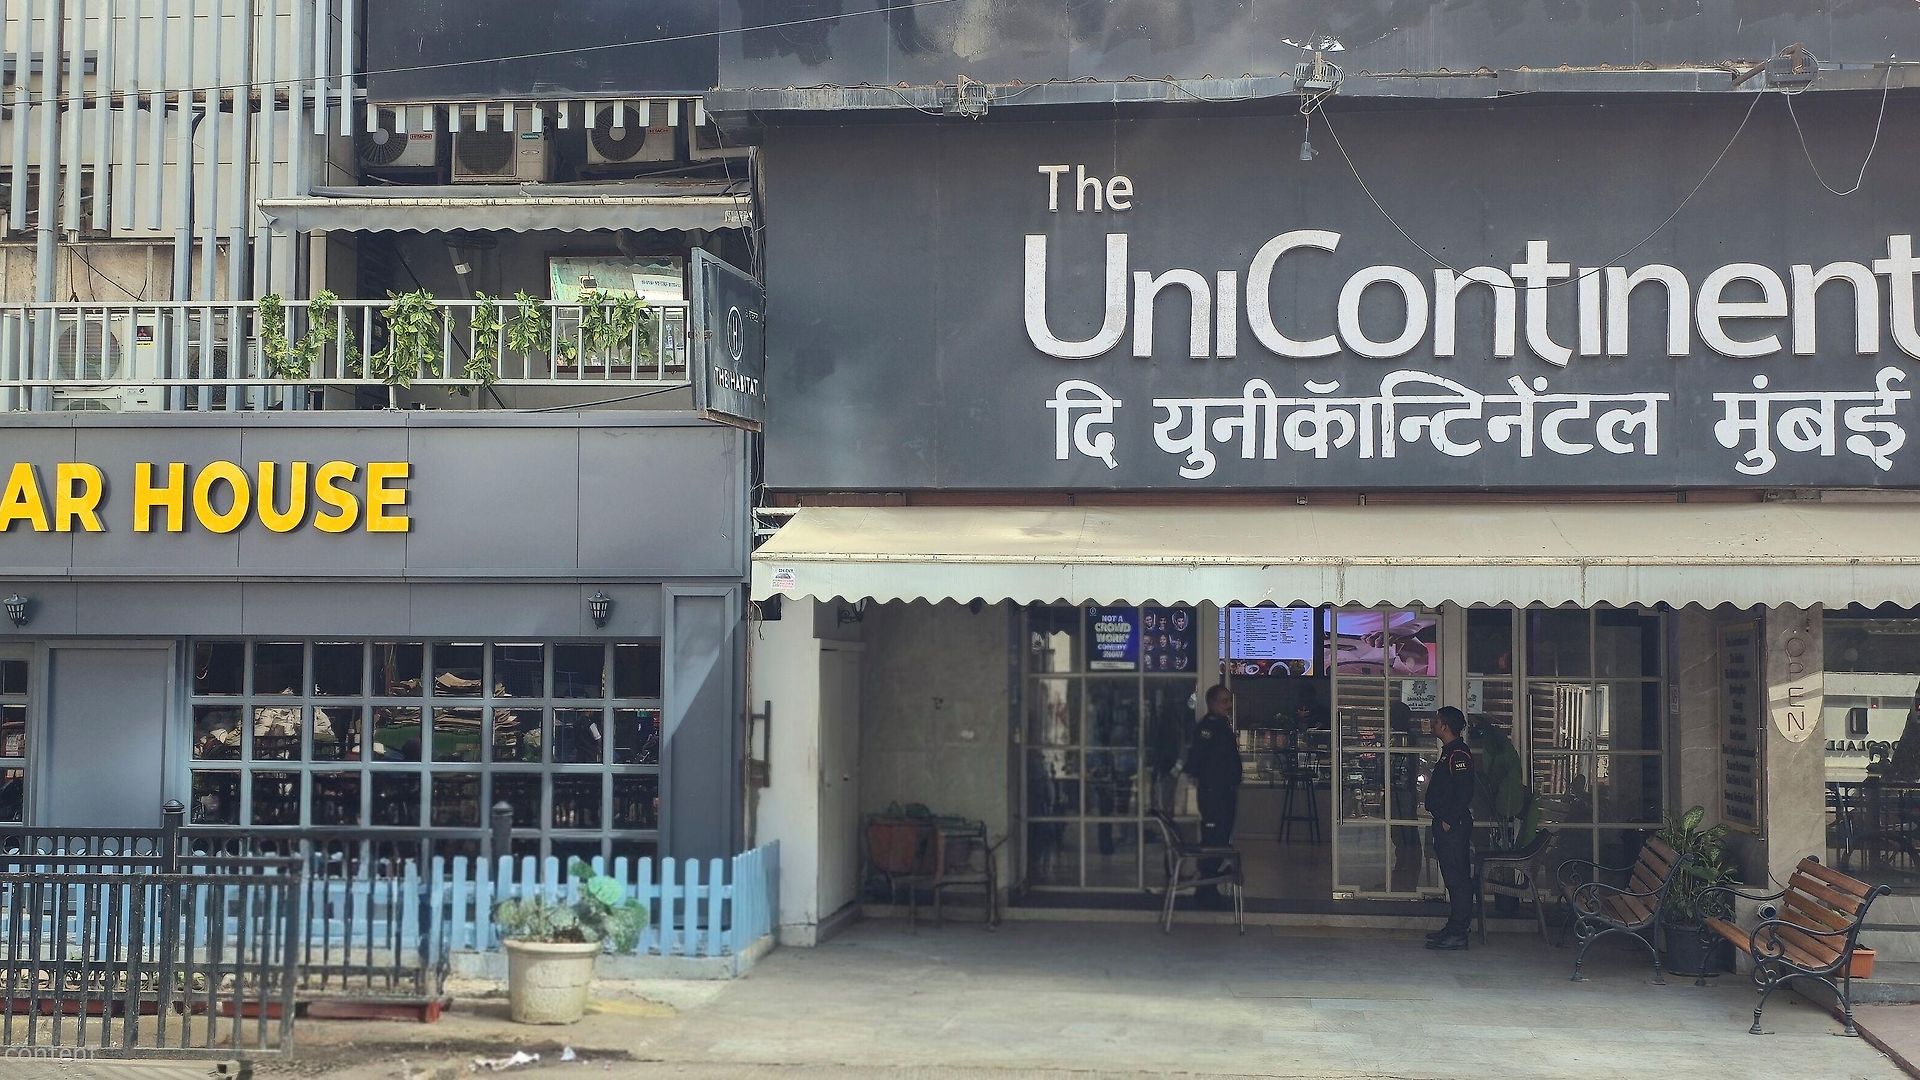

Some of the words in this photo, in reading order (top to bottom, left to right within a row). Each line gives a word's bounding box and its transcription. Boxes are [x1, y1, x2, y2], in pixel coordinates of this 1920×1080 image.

[1038, 164, 1134, 213] The
[1024, 229, 1920, 368] UniContinent
[714, 366, 730, 389] THE
[730, 371, 759, 397] HABITAT
[1046, 379, 1122, 470] दि
[1712, 366, 1911, 476] मुंबई
[0, 461, 105, 533] AR
[133, 460, 410, 534] HOUSE
[1095, 622, 1132, 633] CROWD
[1102, 650, 1124, 658] SHOW
[1786, 637, 1806, 732] OPEN
